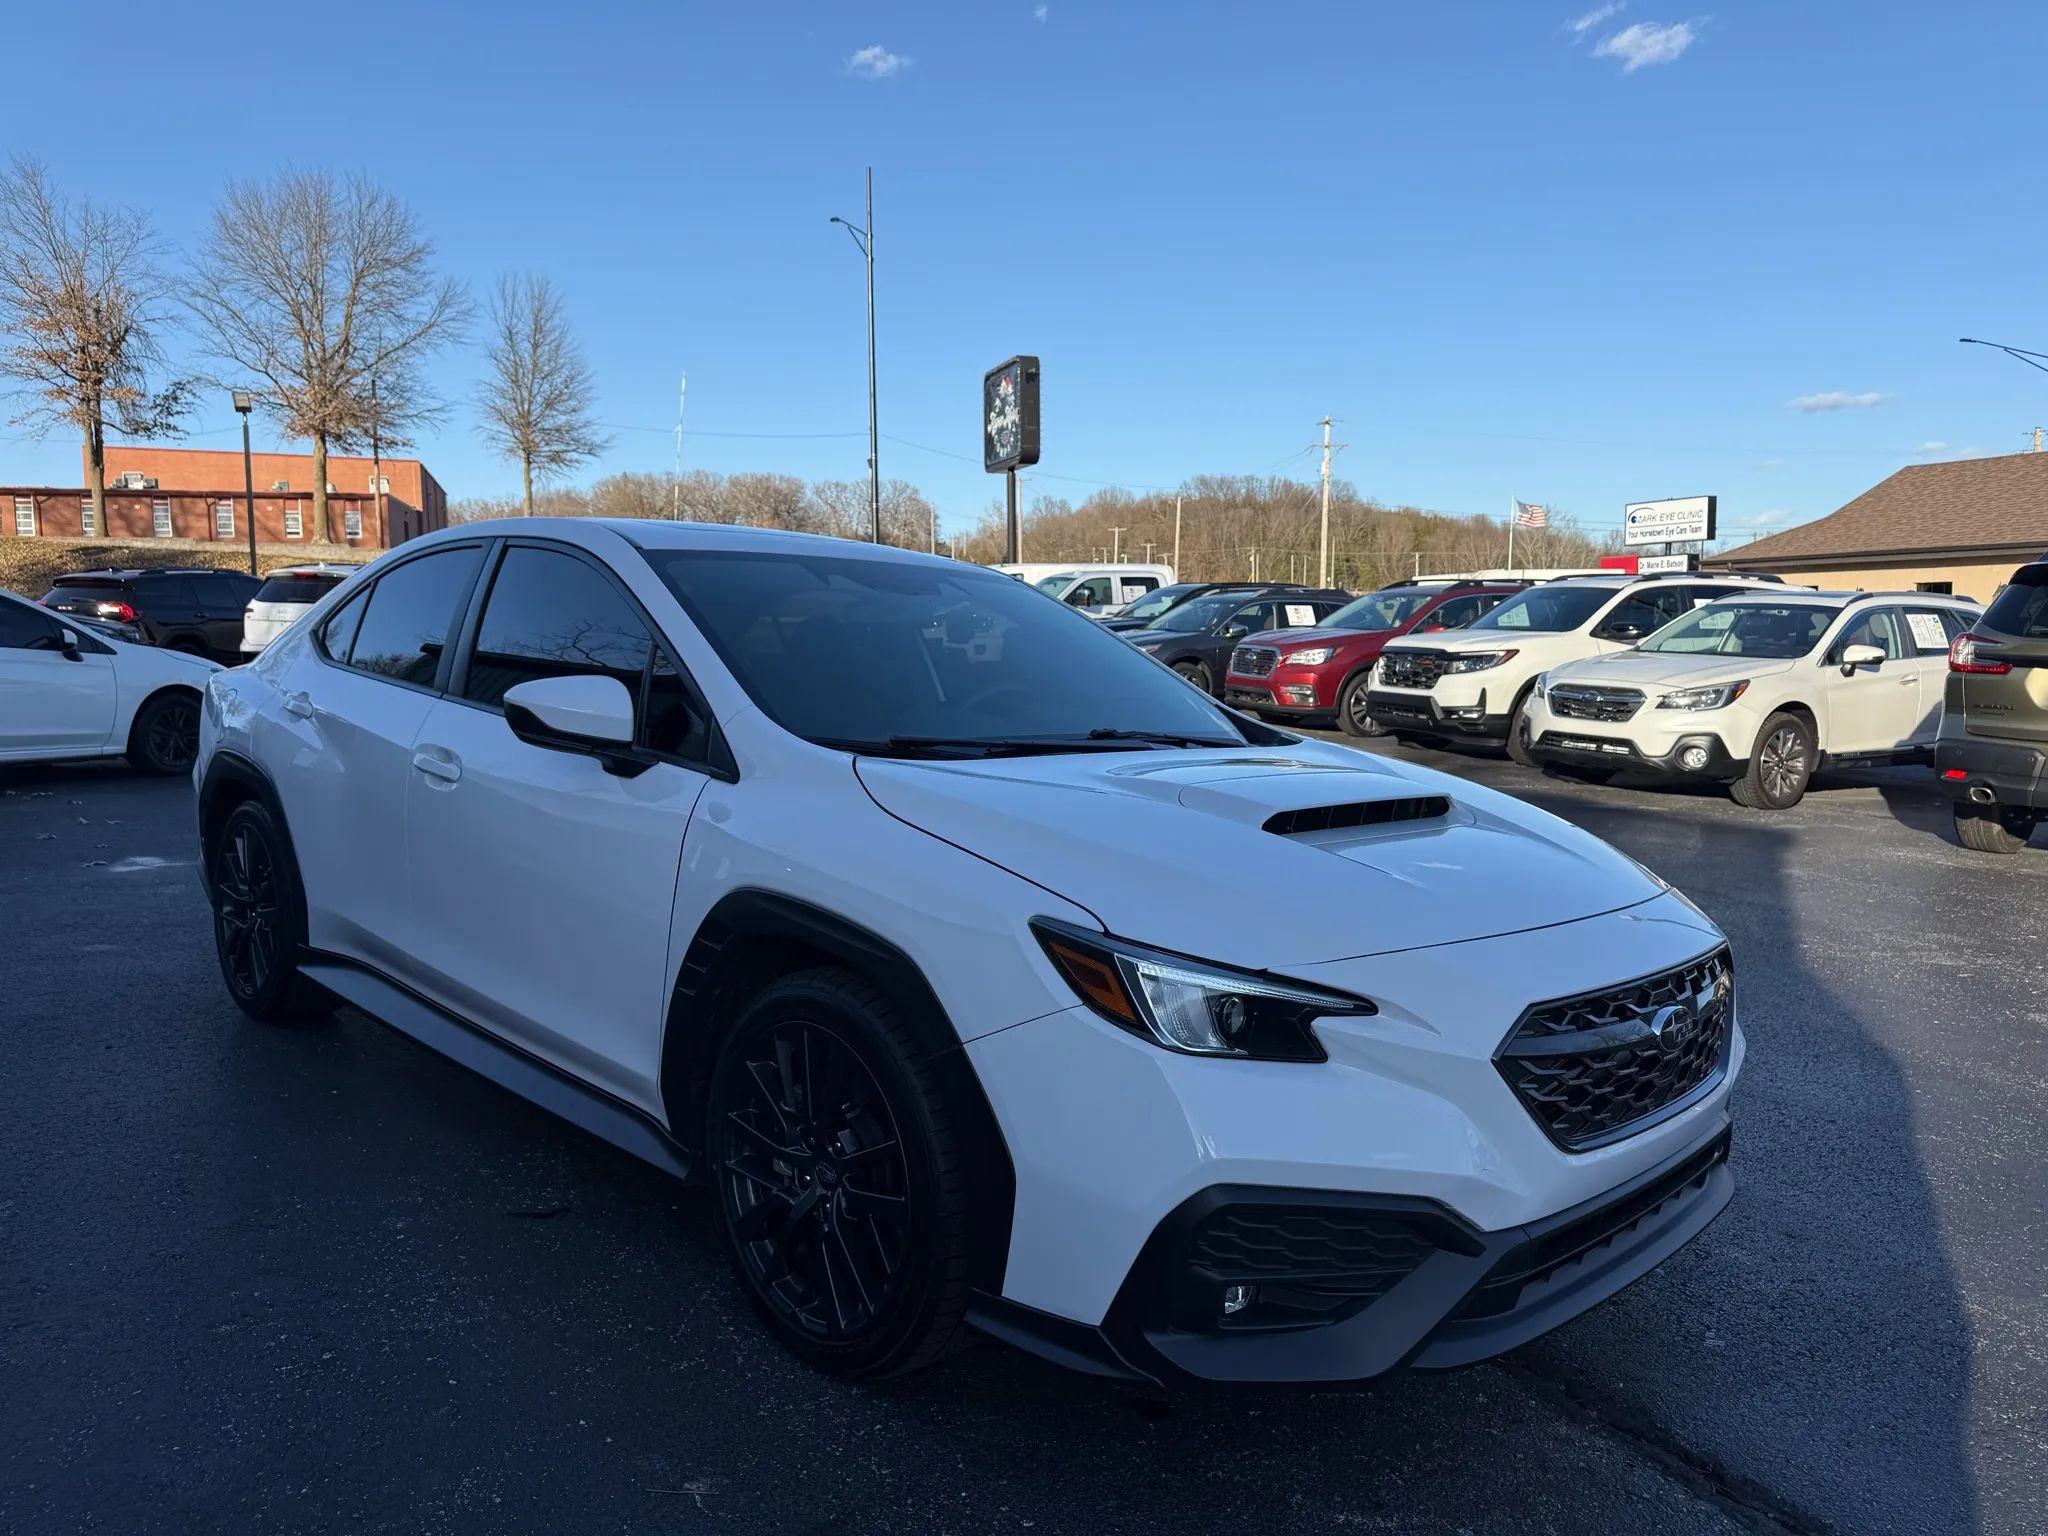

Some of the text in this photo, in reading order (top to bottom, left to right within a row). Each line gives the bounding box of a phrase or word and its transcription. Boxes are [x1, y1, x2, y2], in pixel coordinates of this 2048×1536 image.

[1659, 511, 1676, 522] EYE
[1677, 509, 1703, 519] CLINIC
[1628, 525, 1702, 538] Your Hometown Eye Care Team
